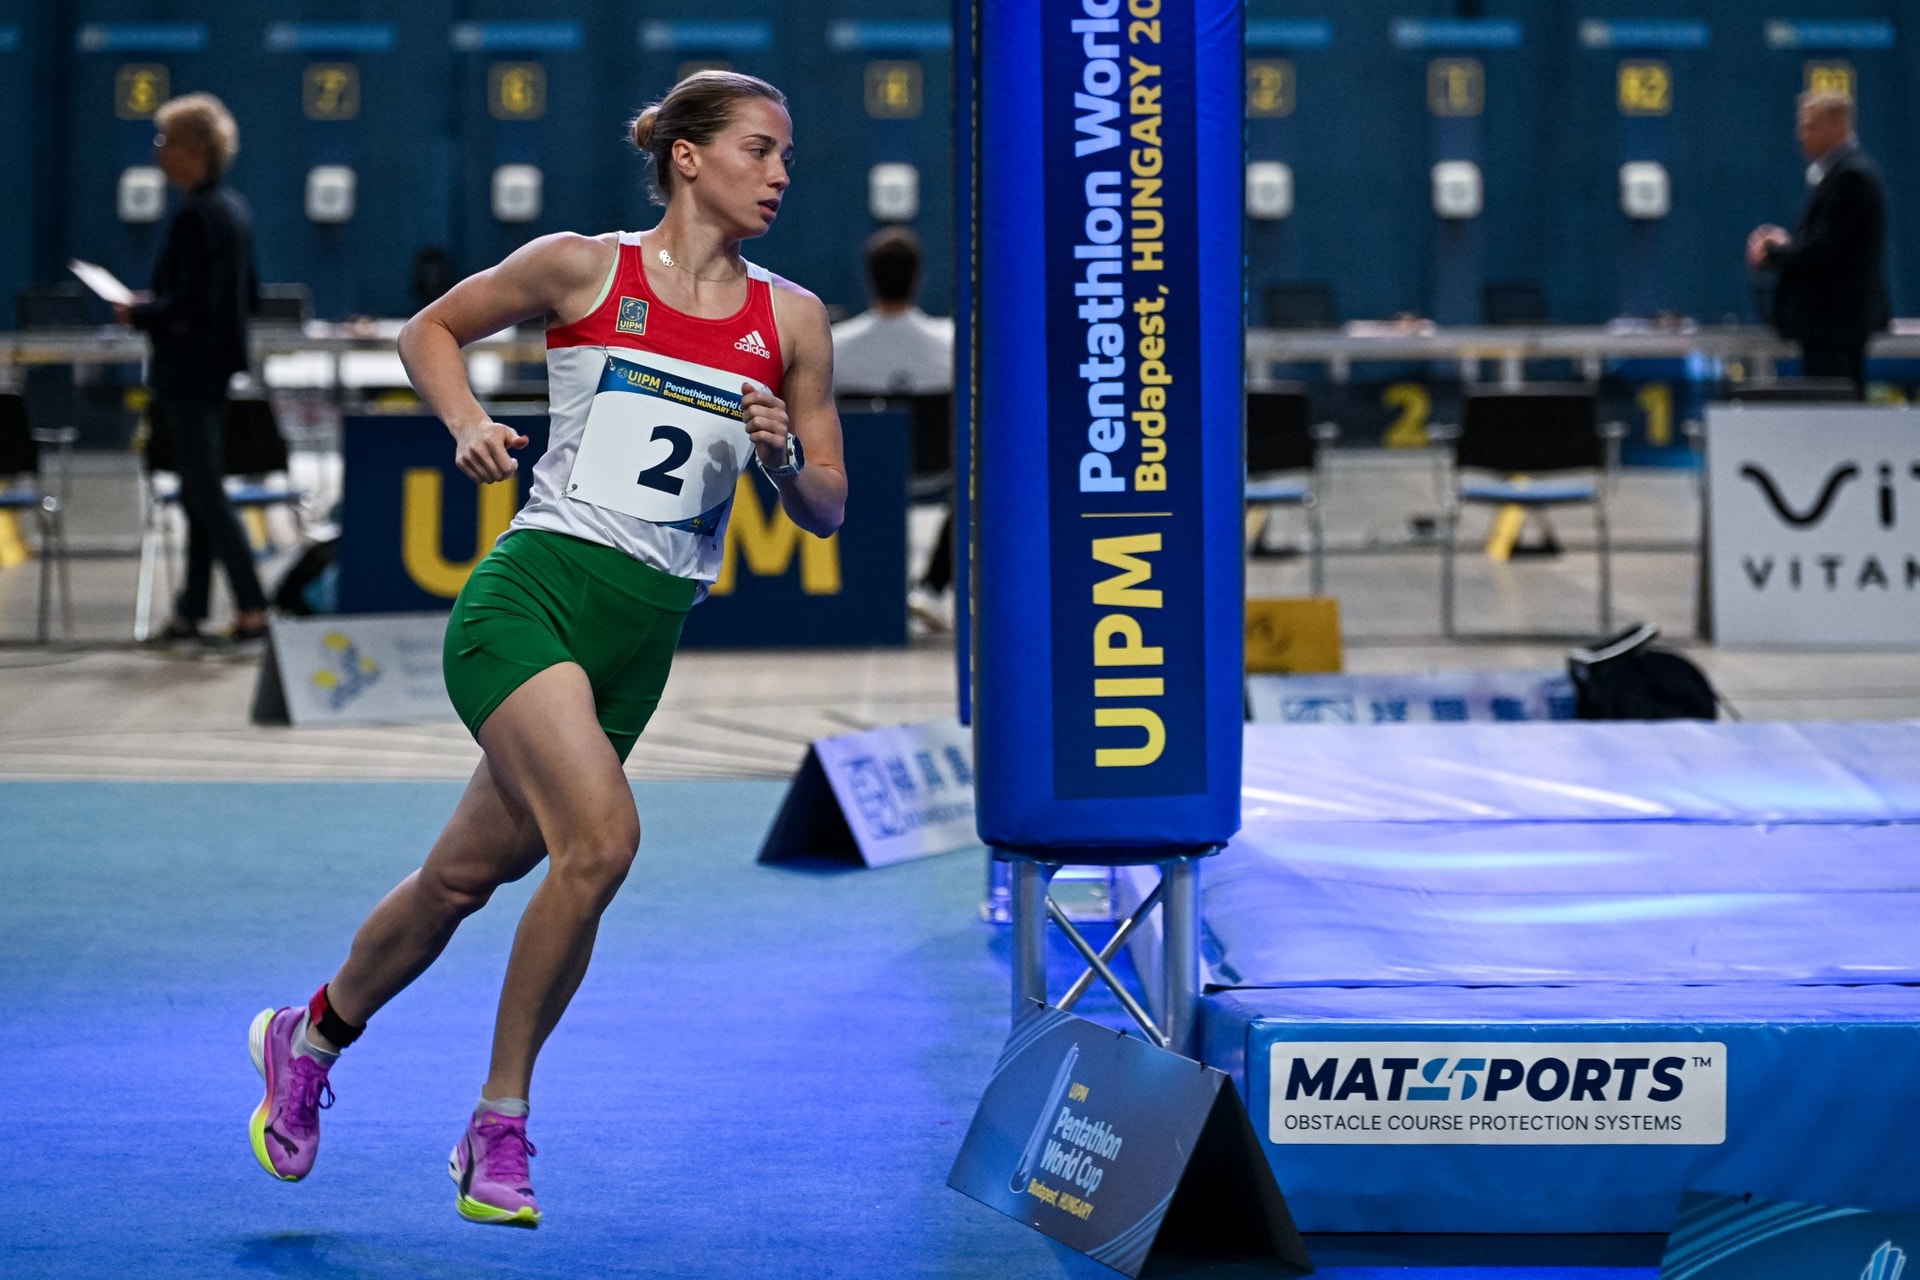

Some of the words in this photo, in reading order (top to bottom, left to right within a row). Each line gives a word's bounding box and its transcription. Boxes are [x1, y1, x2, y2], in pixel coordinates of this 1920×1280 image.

[1129, 56, 1164, 271] HUNGARY
[620, 320, 643, 330] UIPM
[734, 340, 770, 359] adidas
[1074, 171, 1126, 492] Pentathlon
[627, 369, 661, 389] UIPM
[664, 381, 712, 402] Pentathlon
[713, 395, 738, 411] World
[697, 399, 730, 415] HUNGARY
[1132, 284, 1173, 491] Budapest,
[1382, 382, 1431, 448] 2
[1635, 384, 1673, 447] 1
[636, 425, 693, 496] 2
[402, 468, 842, 597] UM
[1092, 532, 1166, 767] UIPM
[1285, 1056, 1687, 1102] MATSPORTS
[1052, 1106, 1123, 1161] Pentathlon
[1284, 1114, 1382, 1131] OBSTACLE
[1388, 1114, 1463, 1131] COURSE
[1469, 1114, 1588, 1131] PROTECTION
[1594, 1114, 1682, 1131] SYSTEMS
[1040, 1139, 1084, 1182] World
[1075, 1155, 1104, 1198] Cup
[1057, 1191, 1095, 1221] HUNGARY
